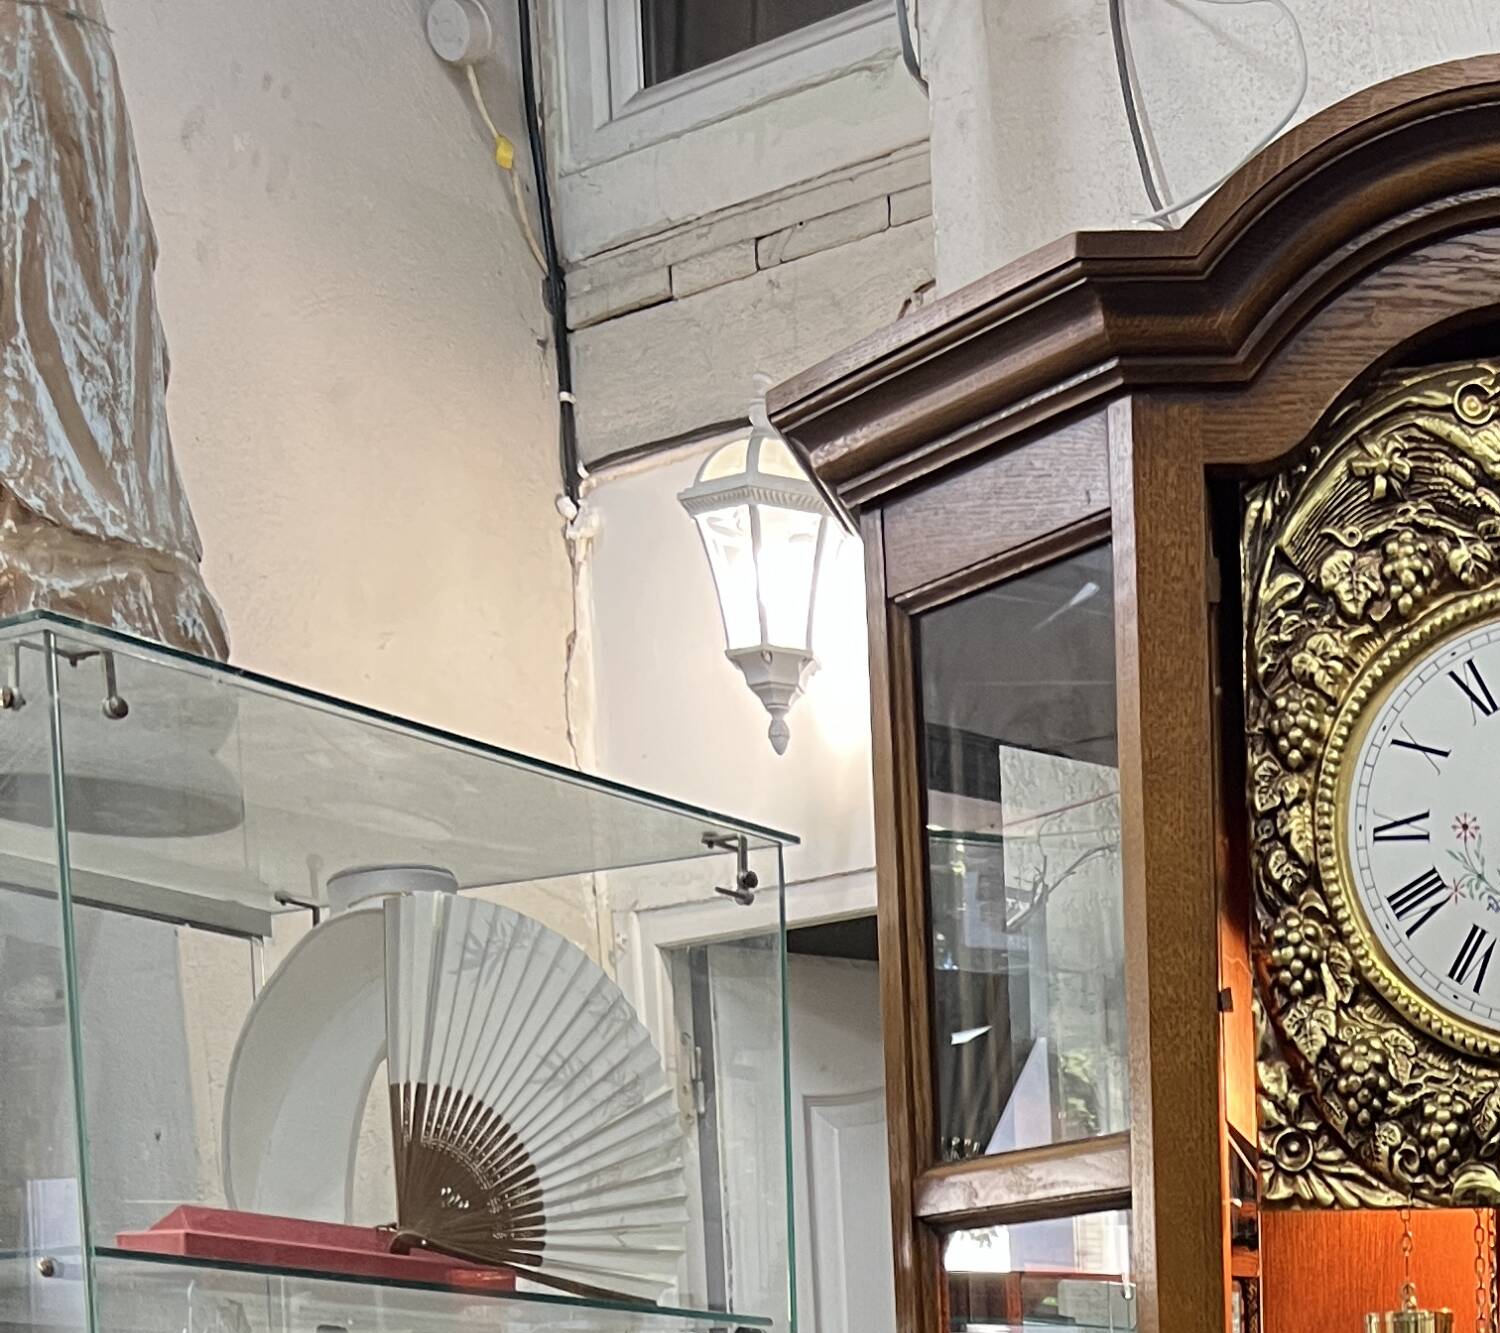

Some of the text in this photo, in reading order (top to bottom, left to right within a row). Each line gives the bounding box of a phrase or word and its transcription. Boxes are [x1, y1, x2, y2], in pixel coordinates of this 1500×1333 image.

[1390, 721, 1452, 776] X
[1372, 809, 1431, 846] IX
[1386, 865, 1452, 939] VIII
[1446, 923, 1498, 995] VII
